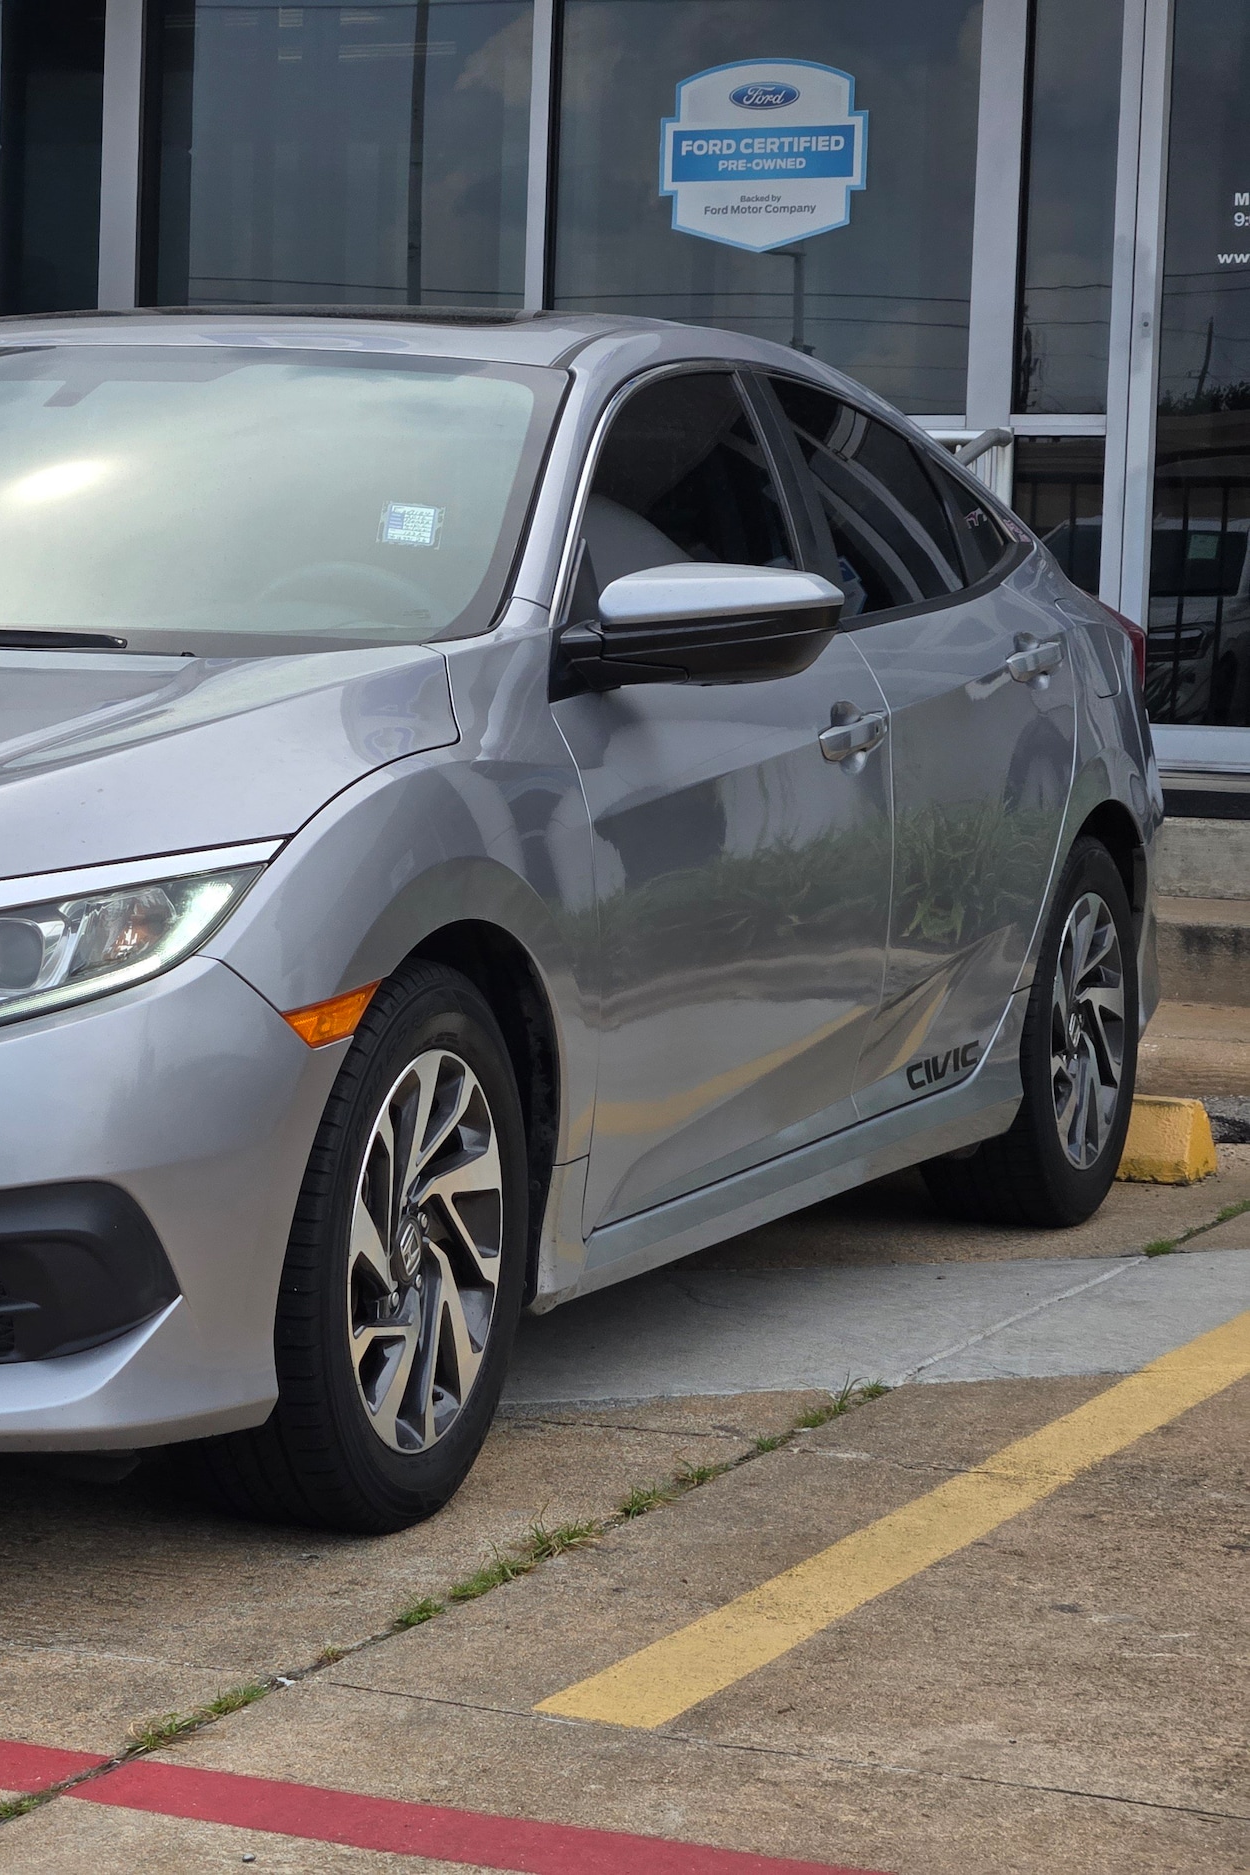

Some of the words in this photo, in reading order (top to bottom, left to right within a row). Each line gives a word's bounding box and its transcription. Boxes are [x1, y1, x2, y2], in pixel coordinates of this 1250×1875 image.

[743, 86, 784, 105] Ford
[681, 139, 736, 156] FORD
[740, 135, 845, 154] CERTIFIED
[718, 158, 806, 171] PRE-OWNED
[740, 194, 769, 203] Backed
[770, 195, 782, 204] by
[704, 205, 728, 215] Ford
[730, 204, 762, 214] Motor
[764, 204, 817, 215] Company
[1234, 212, 1250, 227] 9:
[906, 1040, 979, 1091] CIVIC
